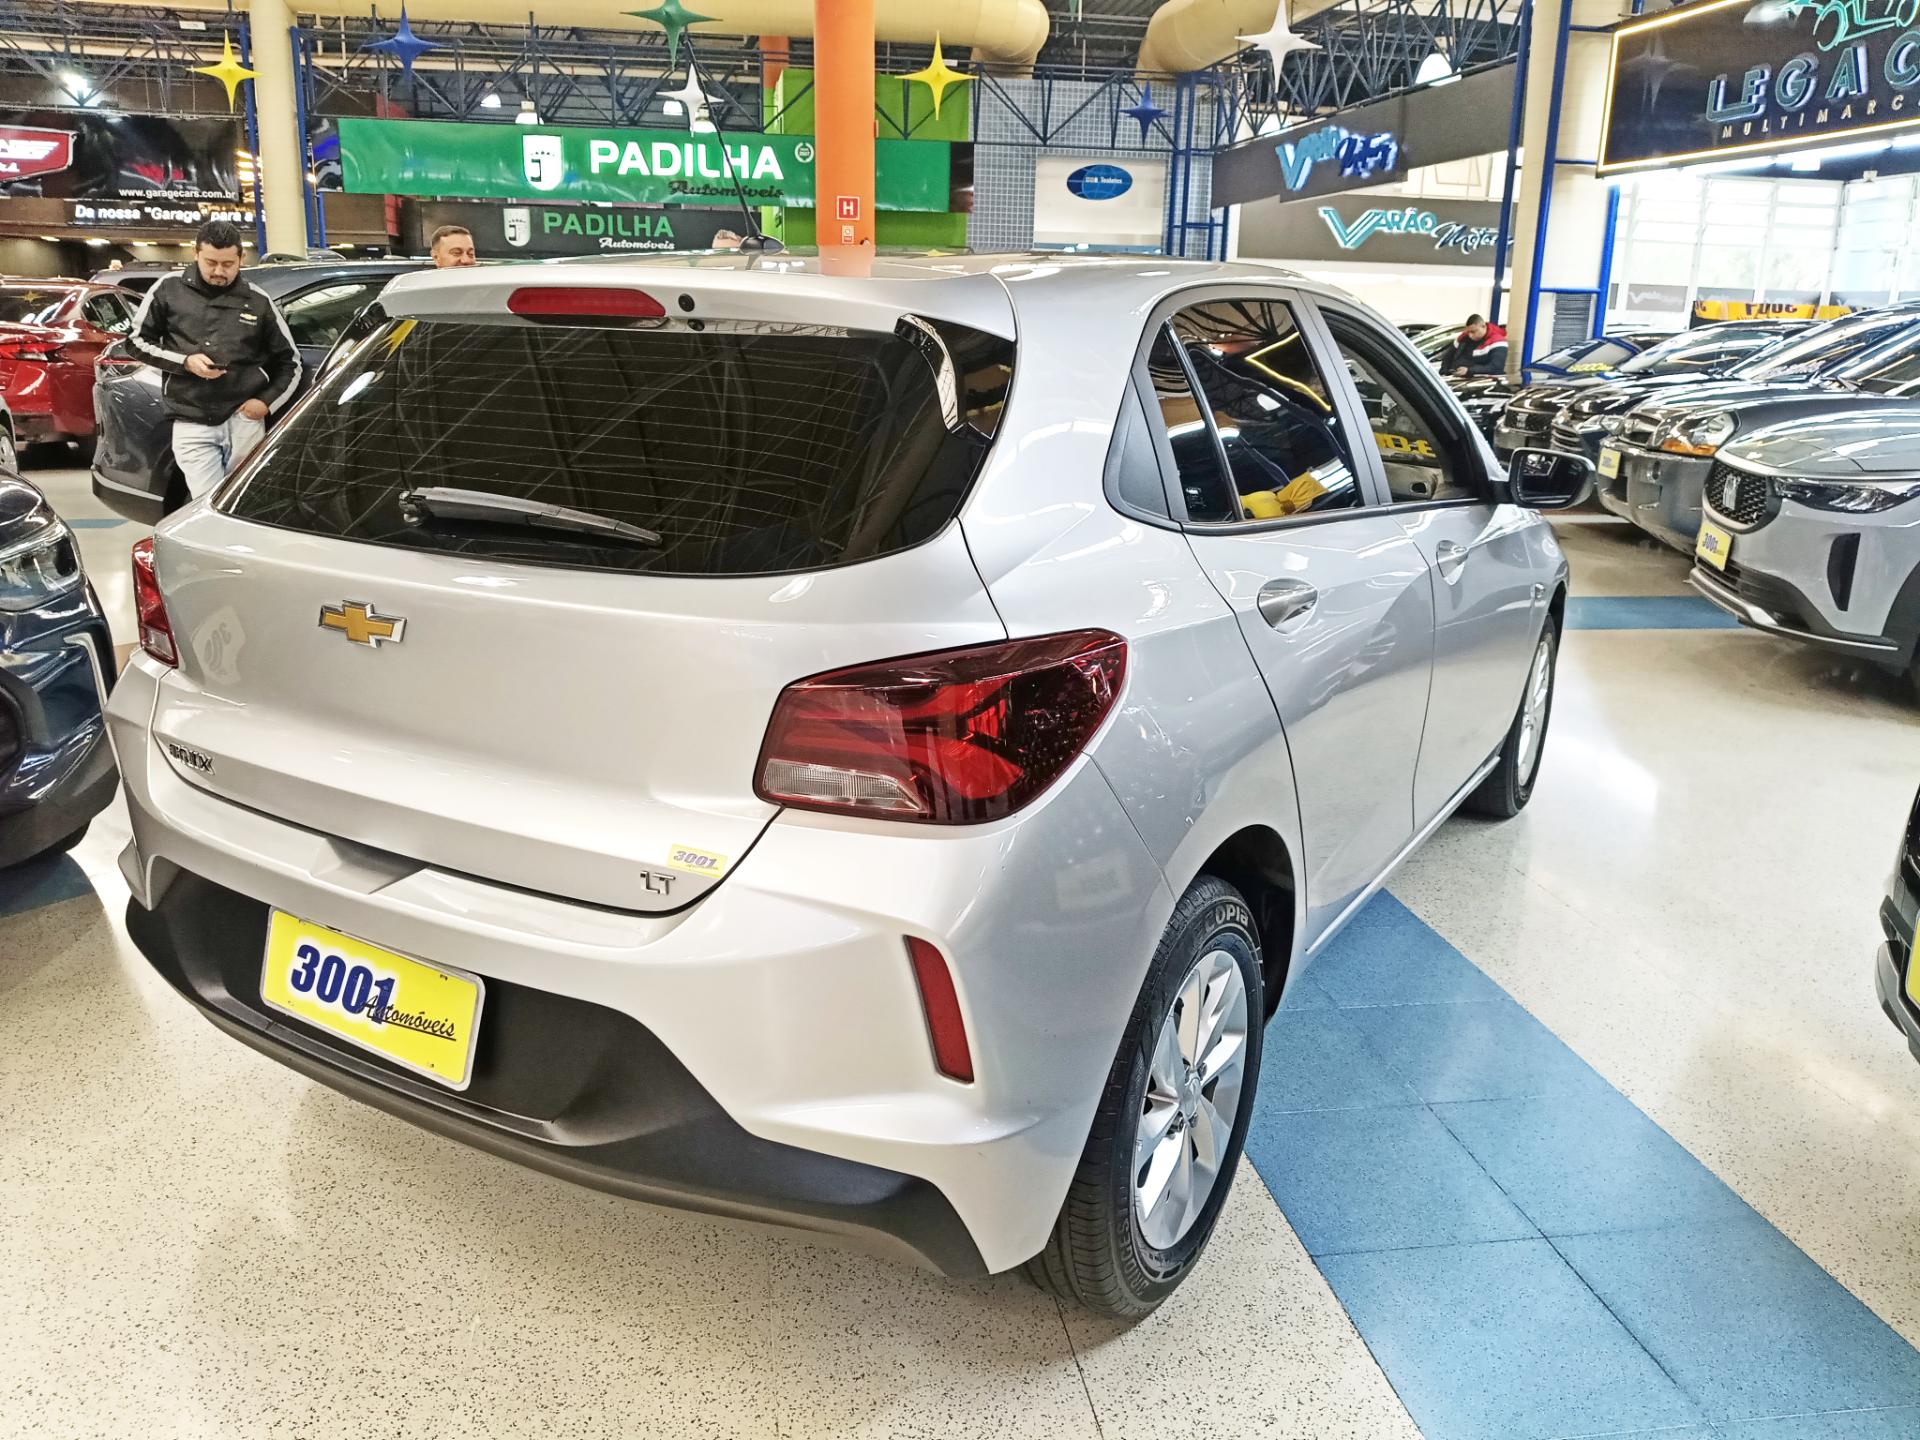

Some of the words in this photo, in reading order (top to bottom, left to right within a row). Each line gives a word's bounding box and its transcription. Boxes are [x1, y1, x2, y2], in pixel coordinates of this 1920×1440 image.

[1722, 94, 1920, 139] MULTIMARC
[590, 139, 784, 180] PADILHA
[119, 188, 235, 199] www.garagecars.com.br
[98, 208, 141, 220] nossa
[543, 212, 675, 238] PADILHA
[1318, 206, 1438, 249] VARÃO
[599, 237, 675, 250] Automóveis
[673, 850, 717, 868] 3001
[640, 870, 676, 895] LT
[290, 944, 396, 1025] 3001
[362, 994, 455, 1037] Automóveis
